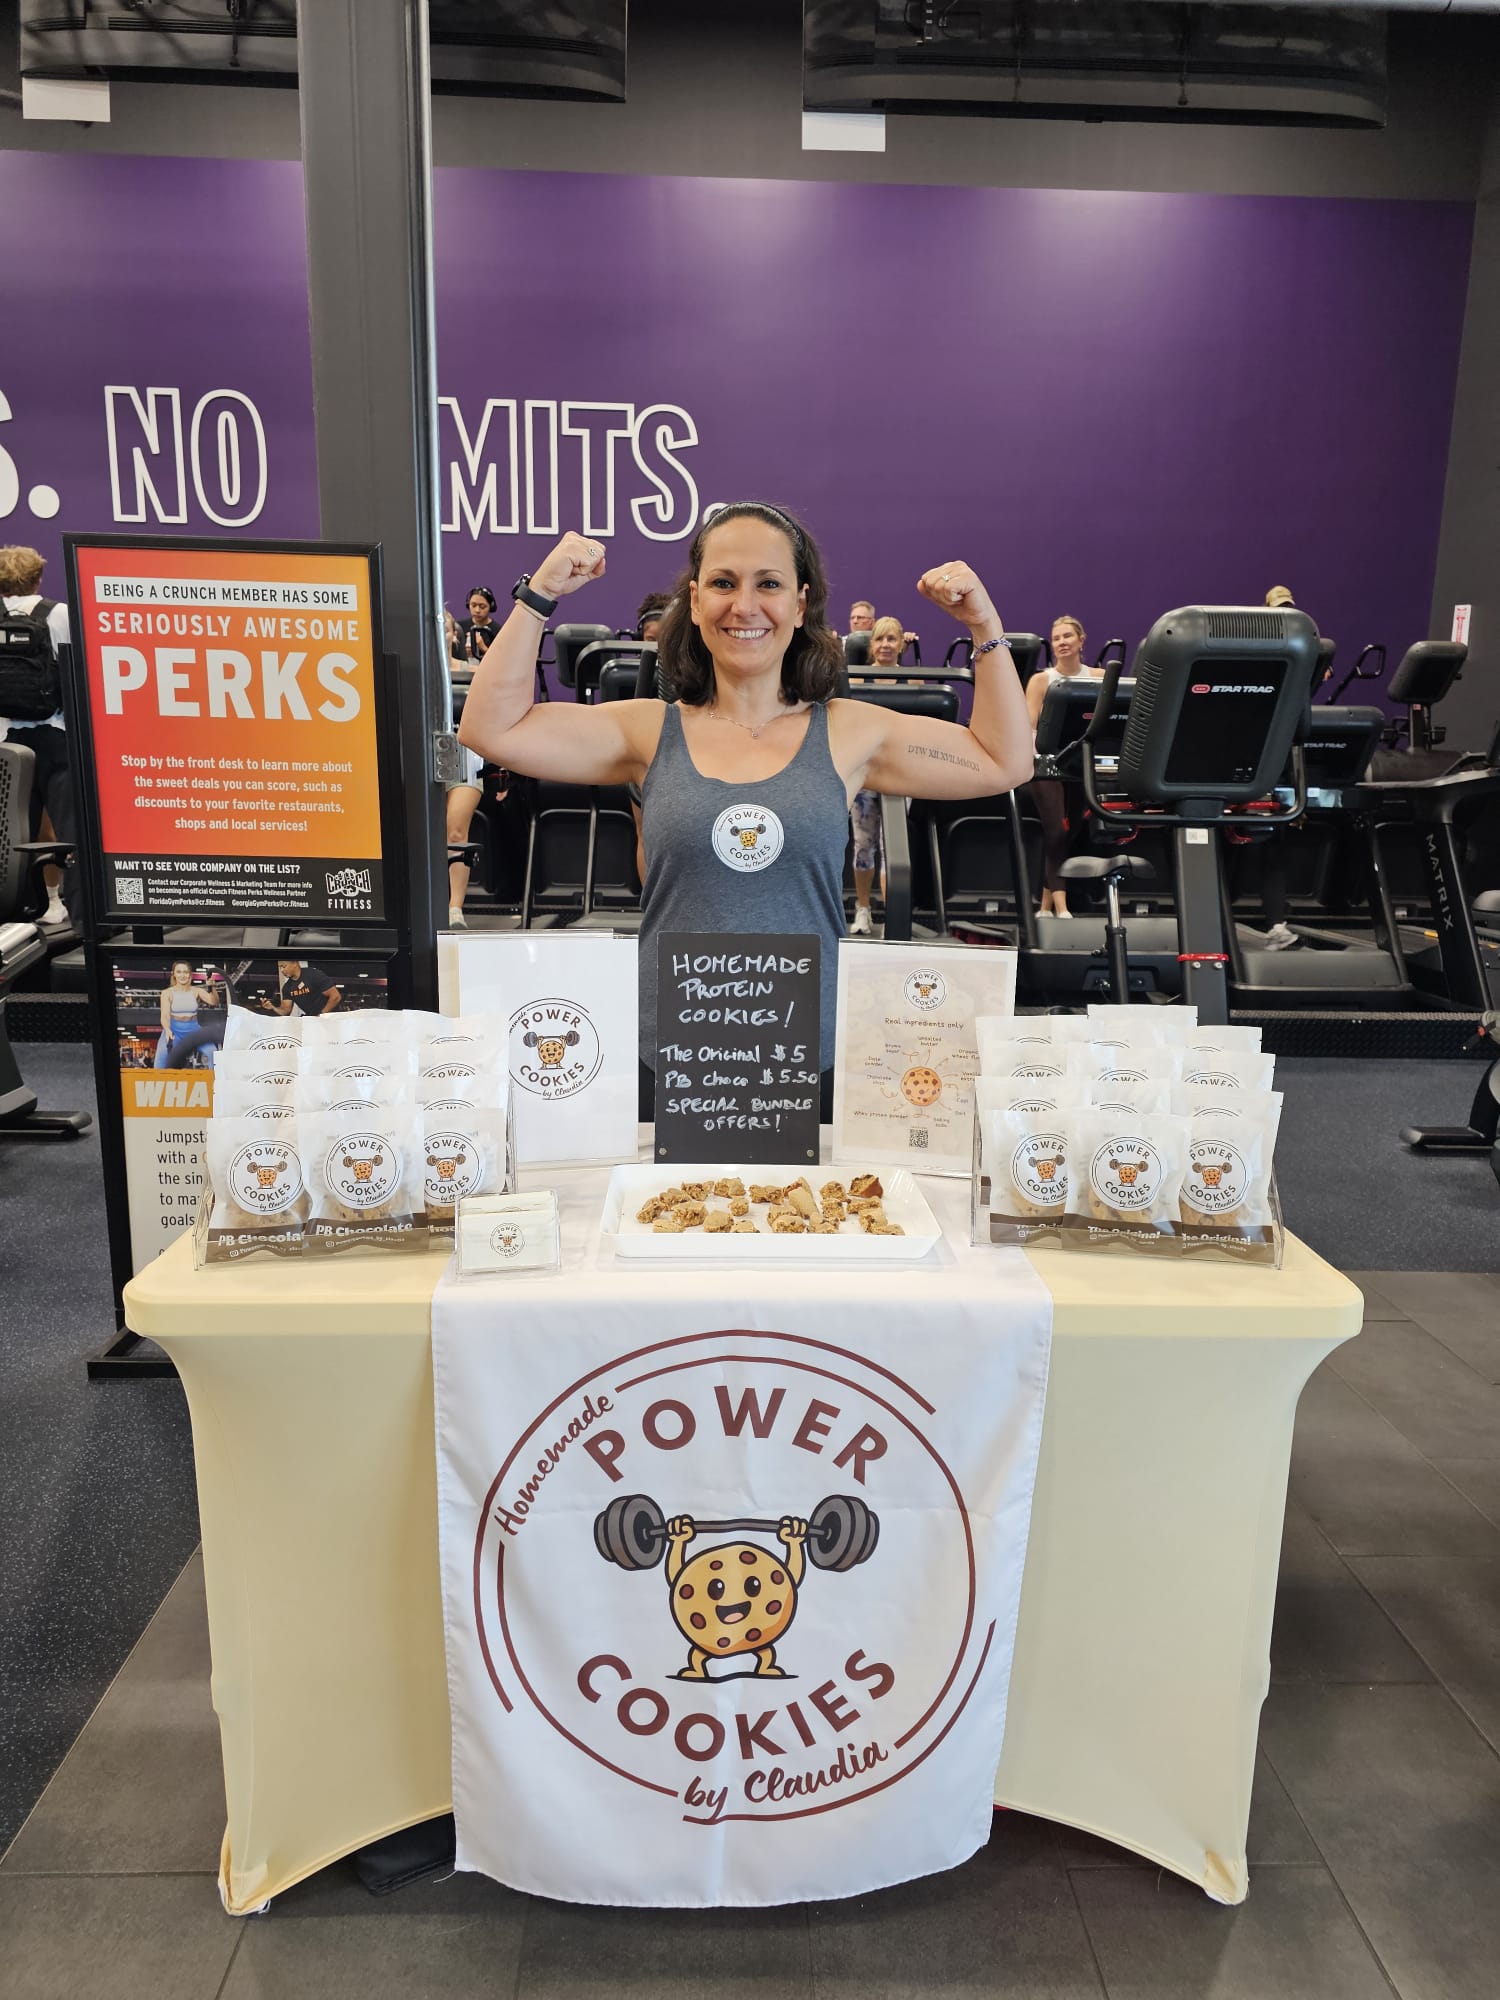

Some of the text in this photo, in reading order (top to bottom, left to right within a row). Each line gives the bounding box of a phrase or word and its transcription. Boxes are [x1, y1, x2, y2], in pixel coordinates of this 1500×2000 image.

[104, 385, 268, 528] NO
[438, 396, 700, 542] MITS
[103, 583, 349, 605] BEING A CRUNCH MEMBER HAS SOME
[98, 612, 359, 641] SERIOUSLY AWESOME
[101, 646, 360, 722] PERKS
[1211, 685, 1276, 693] STAR TRAC
[121, 755, 353, 773] Stop by the front desk to learn more about
[134, 776, 343, 793] the sweet deals you can score, such as
[134, 796, 345, 814] discounts to your favorite restaurants,
[175, 817, 308, 832] shops and local services!
[728, 811, 766, 824] POWER
[730, 844, 771, 861] COOKIES
[114, 860, 301, 874] WANT TO SEE YOUR COMPANY ON THE LIST?
[147, 878, 169, 886] Contact
[180, 879, 207, 888] Corporate
[237, 880, 263, 889] Marketing
[302, 881, 313, 889] info
[325, 868, 372, 896] CRUNCH
[1426, 833, 1454, 931] MATRIX
[156, 887, 182, 895] becoming
[190, 887, 208, 895] official
[228, 888, 247, 896] Fitness
[263, 889, 286, 897] Wellness
[328, 899, 372, 910] FITNESS
[672, 953, 812, 976] HOMEMADE
[678, 977, 774, 1001] PROTEIN
[521, 1009, 581, 1030] POWER
[904, 1019, 945, 1028] ingredients
[948, 1021, 964, 1029] only
[660, 1043, 693, 1063] The
[697, 1044, 761, 1064] Original
[520, 1062, 585, 1087] COOKIES
[135, 1080, 209, 1108] WHA
[665, 1097, 812, 1115] SPECIAL BUNDLE
[704, 1114, 781, 1132] OFFERS!
[156, 1130, 207, 1146] Jumpst
[340, 1140, 384, 1154] POWER
[425, 1139, 466, 1154] POWER
[246, 1147, 289, 1160] POWER
[1026, 1141, 1064, 1154] POWER
[1108, 1144, 1150, 1159] POWER
[1190, 1146, 1233, 1161] POWER
[157, 1151, 197, 1164] with a
[159, 1172, 203, 1185] the sin
[340, 1177, 387, 1196] COOKIES
[425, 1175, 470, 1194] COOKIES
[243, 1183, 291, 1201] COOKIES
[1105, 1181, 1151, 1199] COOKIES
[1190, 1184, 1236, 1202] COOKIES
[160, 1193, 200, 1206] to ma
[161, 1213, 195, 1229] goals
[316, 1224, 333, 1237] PB
[336, 1222, 413, 1237] Chocolate
[218, 1231, 305, 1247] PB Chocolat
[582, 1384, 889, 1485] POWER
[494, 1392, 615, 1536] Homemade
[576, 1648, 896, 1763] COOKIES
[683, 1739, 889, 1826] by Claudia
